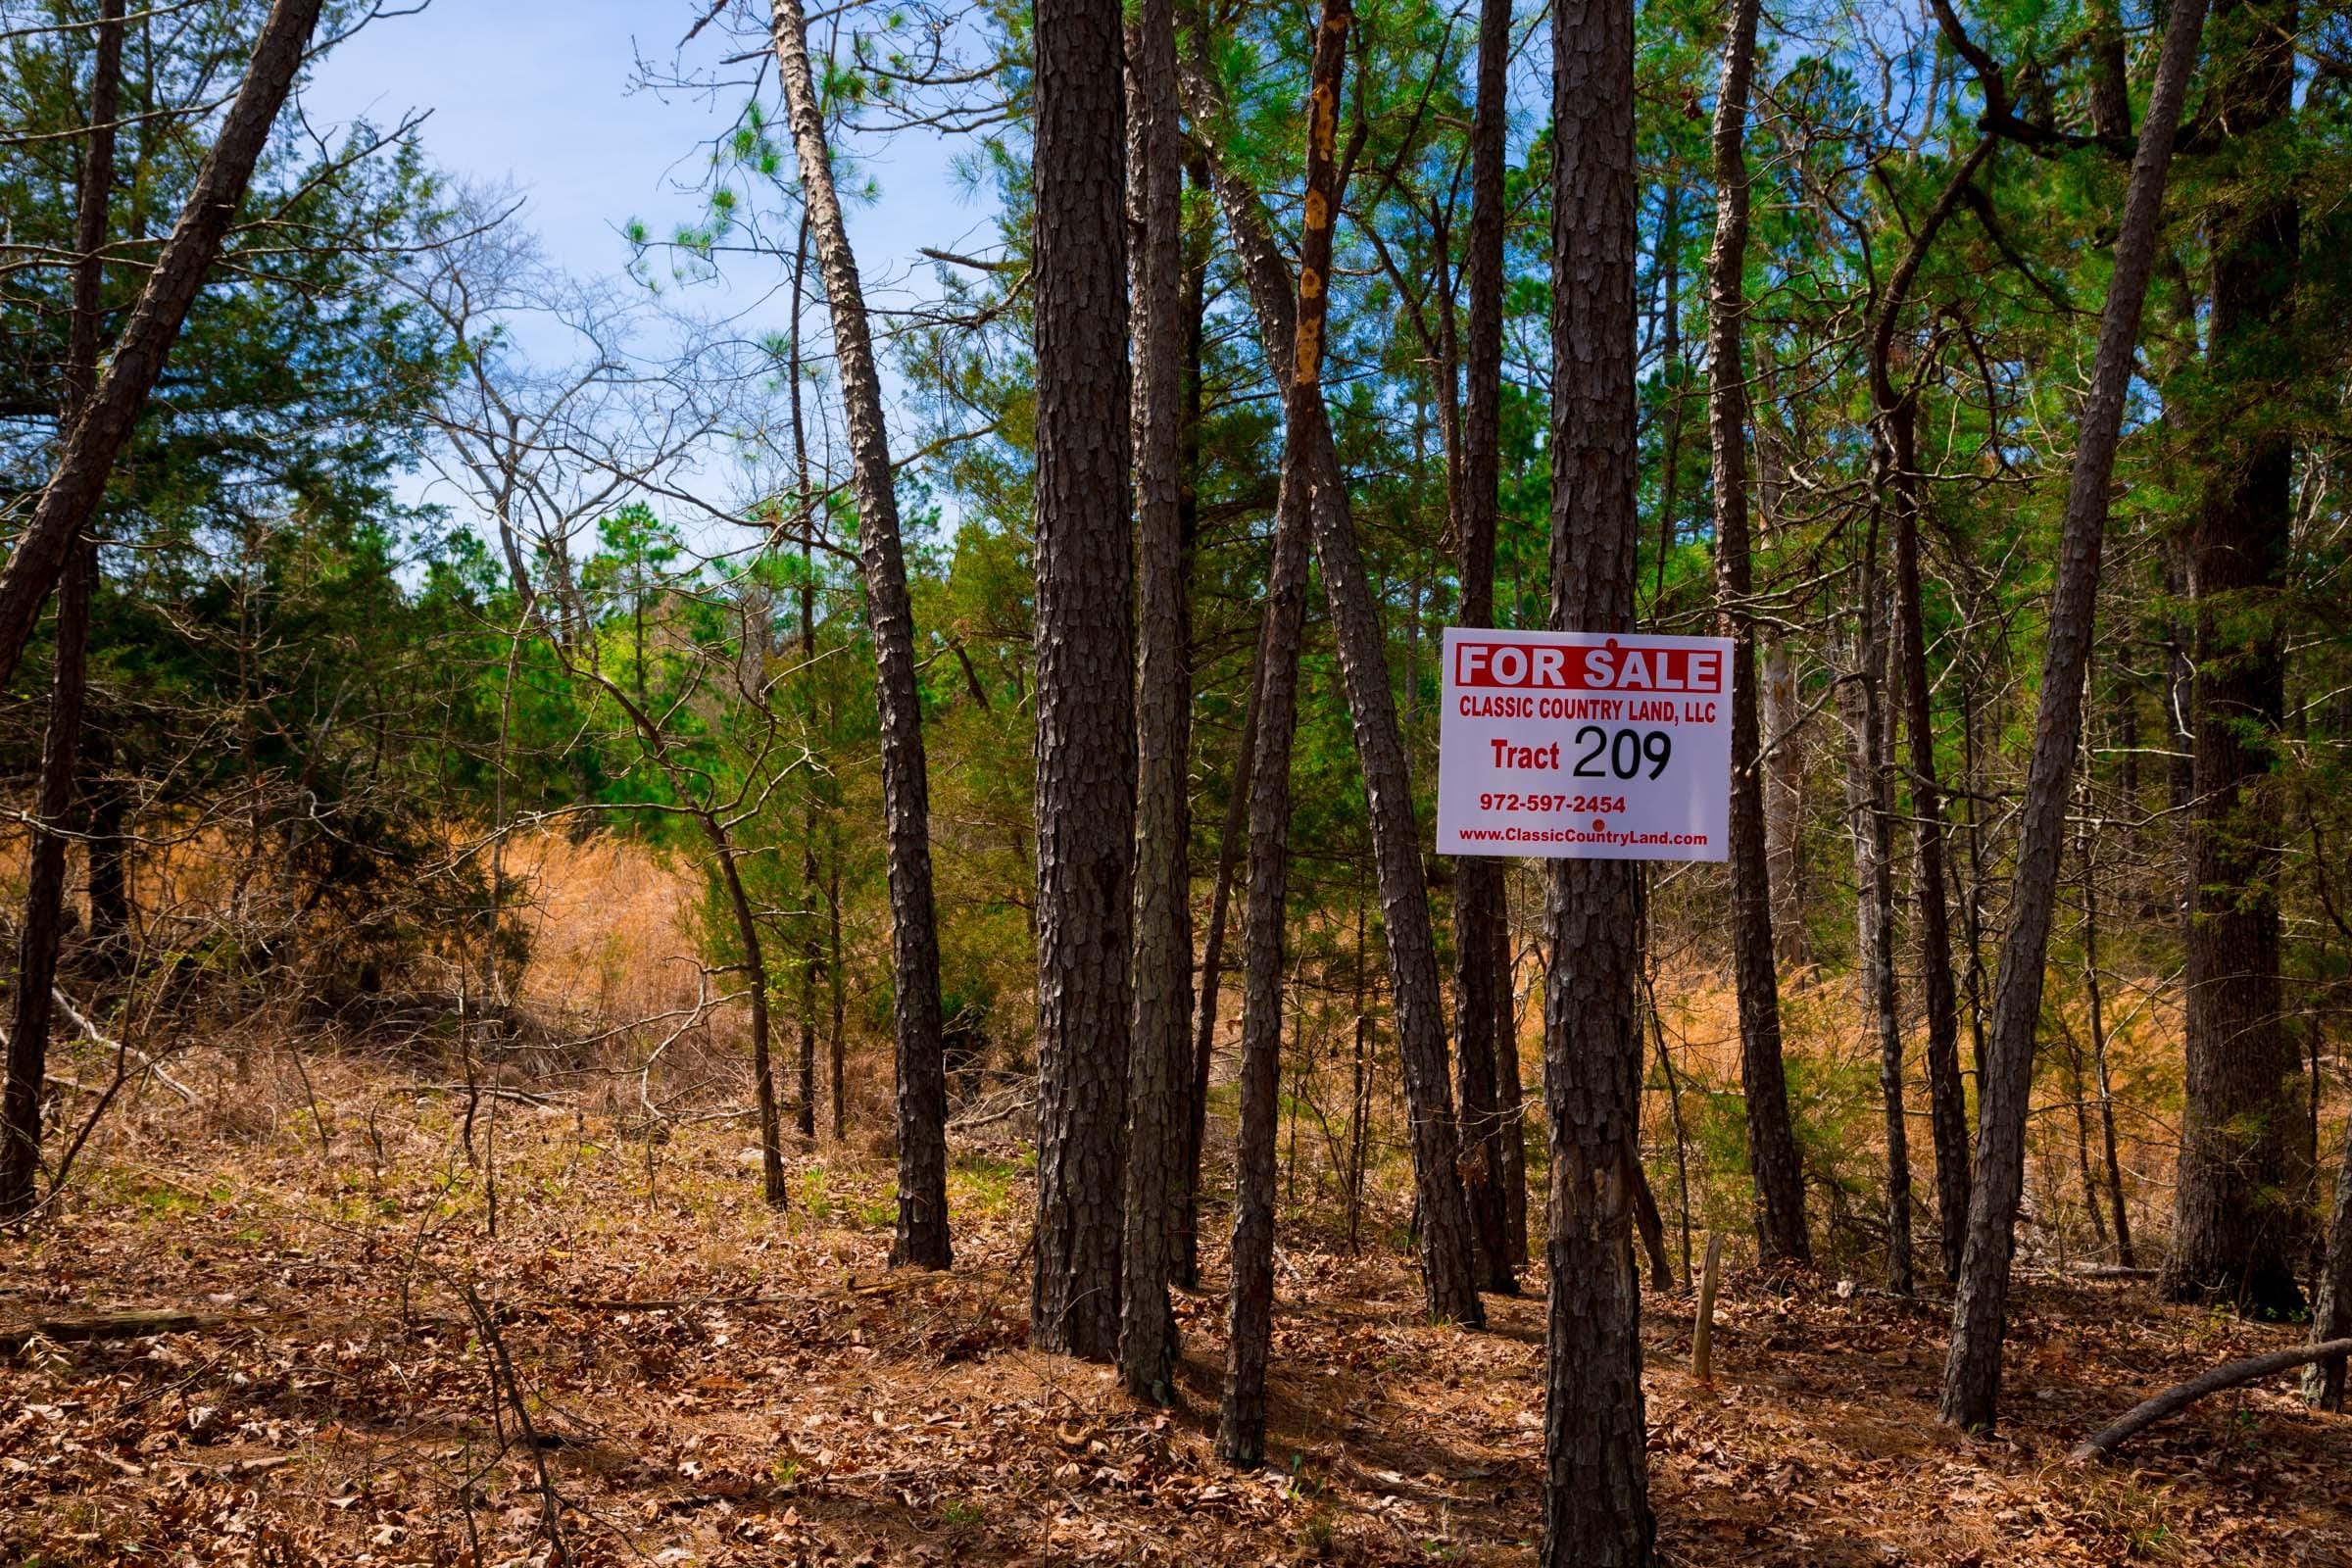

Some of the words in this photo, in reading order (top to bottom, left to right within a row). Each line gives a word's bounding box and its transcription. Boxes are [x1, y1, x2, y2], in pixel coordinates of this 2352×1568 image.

[1459, 646, 1566, 686] FOR
[1584, 649, 1718, 691] SALE
[1459, 696, 1534, 718] CLASSIC
[1539, 698, 1624, 721] COUNTRY
[1629, 701, 1679, 726] LAND,
[1685, 702, 1716, 723] LLC
[1491, 739, 1560, 769] Tract
[1572, 725, 1672, 781] 209
[1480, 793, 1626, 813] 972-597-2454
[1459, 827, 1708, 847] www.ClassicCountryLand.com
